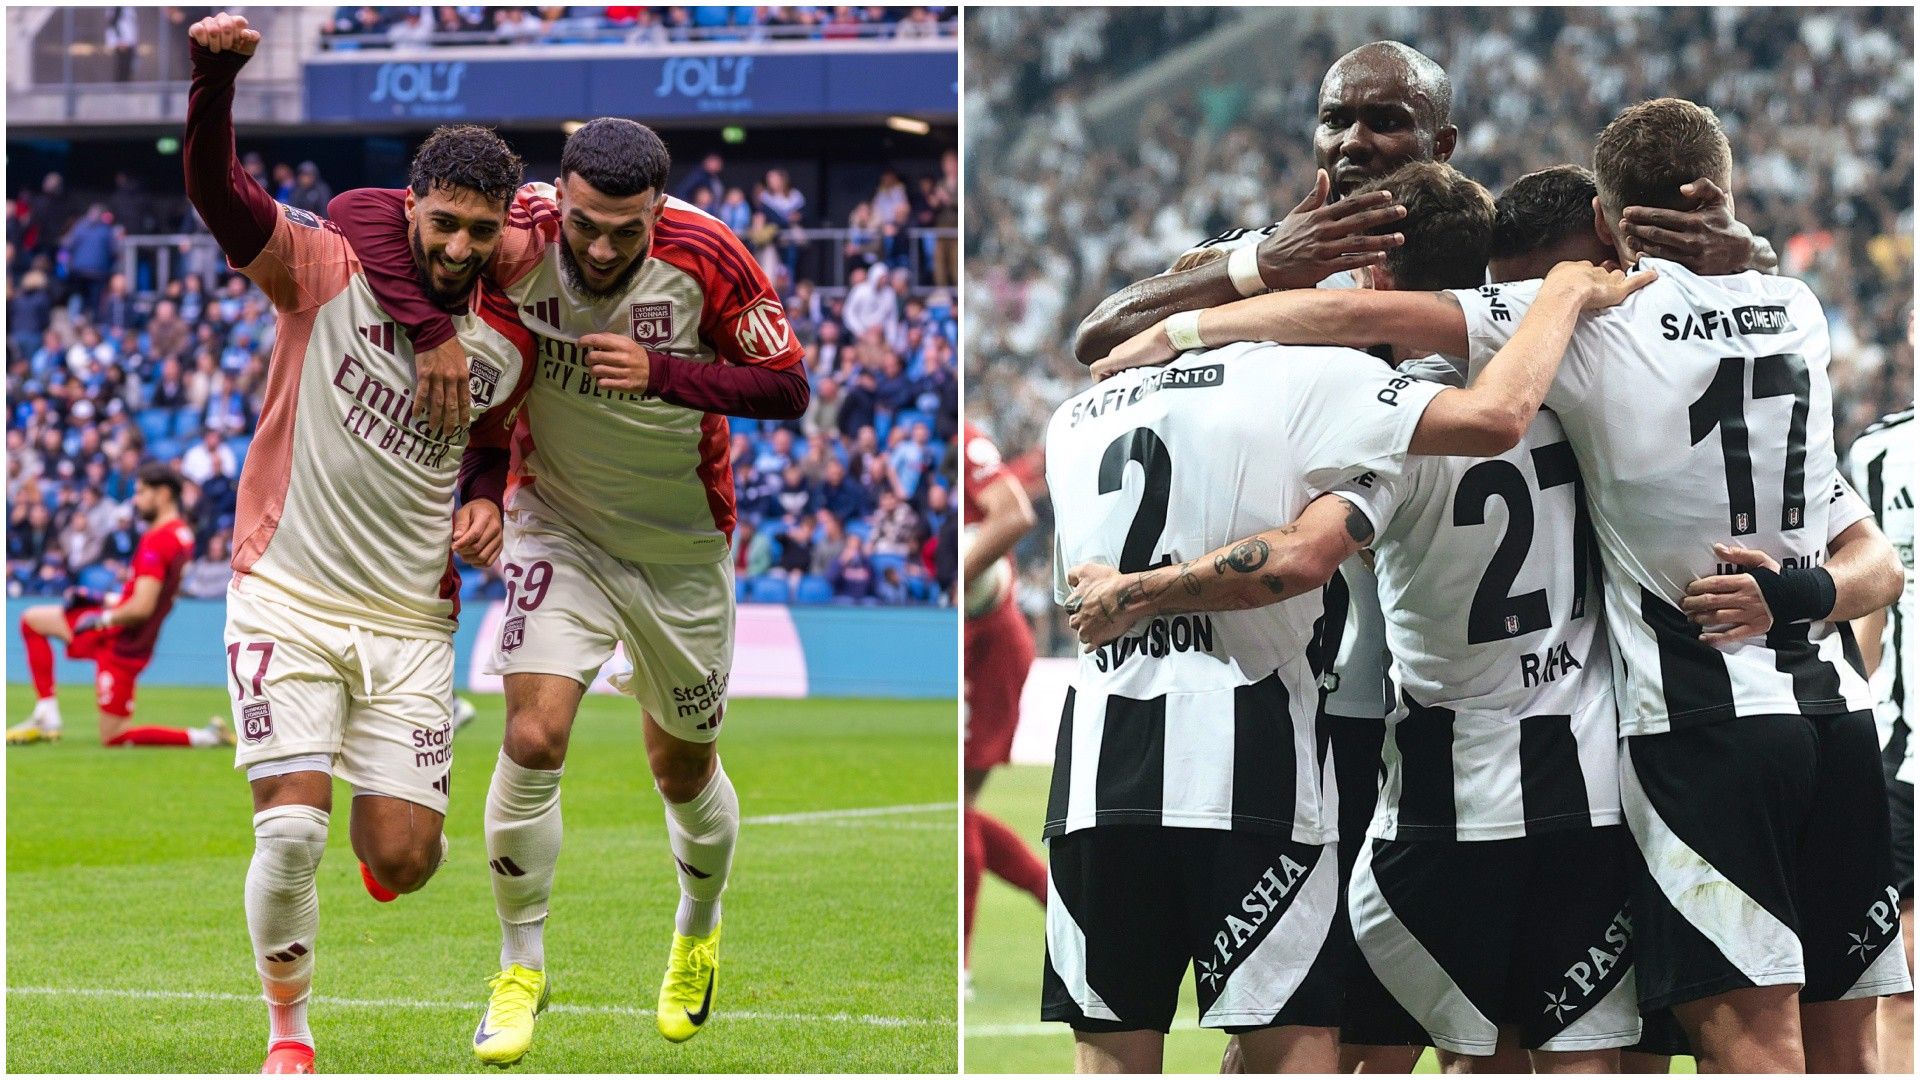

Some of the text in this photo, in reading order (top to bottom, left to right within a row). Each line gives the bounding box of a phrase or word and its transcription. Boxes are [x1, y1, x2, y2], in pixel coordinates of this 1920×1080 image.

[635, 310, 669, 319] LYONNAIS
[742, 304, 789, 355] MG
[343, 405, 451, 470] FLY BETTER
[1688, 354, 1811, 537] 17
[1098, 427, 1172, 574] 2
[1453, 441, 1586, 645] 27
[227, 641, 275, 701] 17
[673, 670, 718, 702] Staff
[1213, 854, 1308, 966] PASHA
